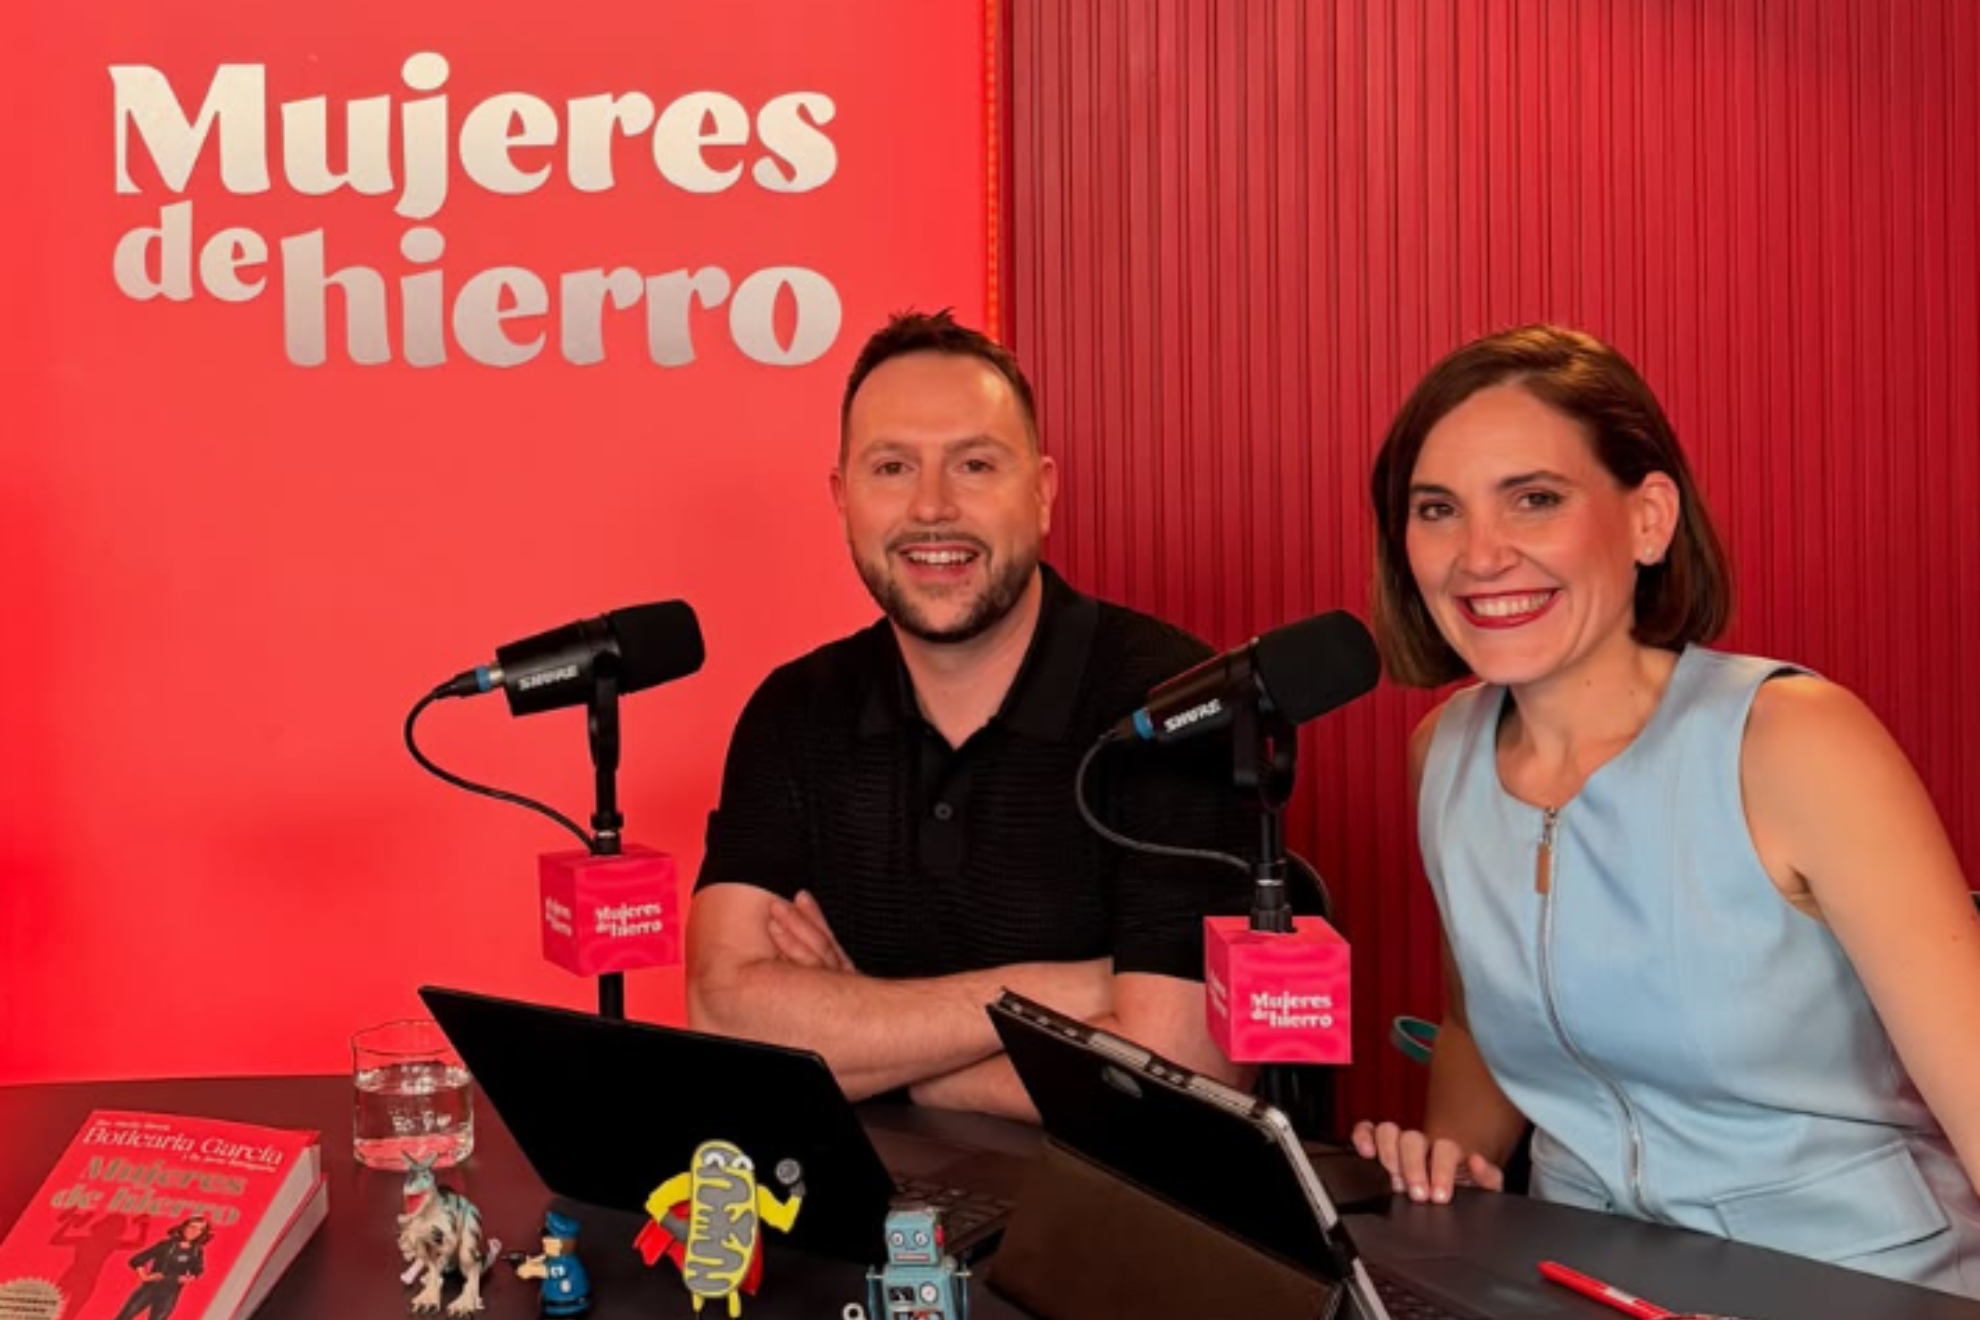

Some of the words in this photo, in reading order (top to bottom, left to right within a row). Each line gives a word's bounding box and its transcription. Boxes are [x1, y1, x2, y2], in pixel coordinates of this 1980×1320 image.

[108, 52, 839, 219] Mujeres
[113, 200, 268, 302] de
[280, 227, 842, 368] hierro
[519, 664, 578, 692] SHURE
[1164, 698, 1222, 733] SHURE
[1251, 990, 1332, 1015] Mujeres
[1268, 1009, 1333, 1028] hierro
[80, 1156, 248, 1195] Mujeres
[51, 1183, 103, 1210] de
[106, 1187, 241, 1226] hierro
